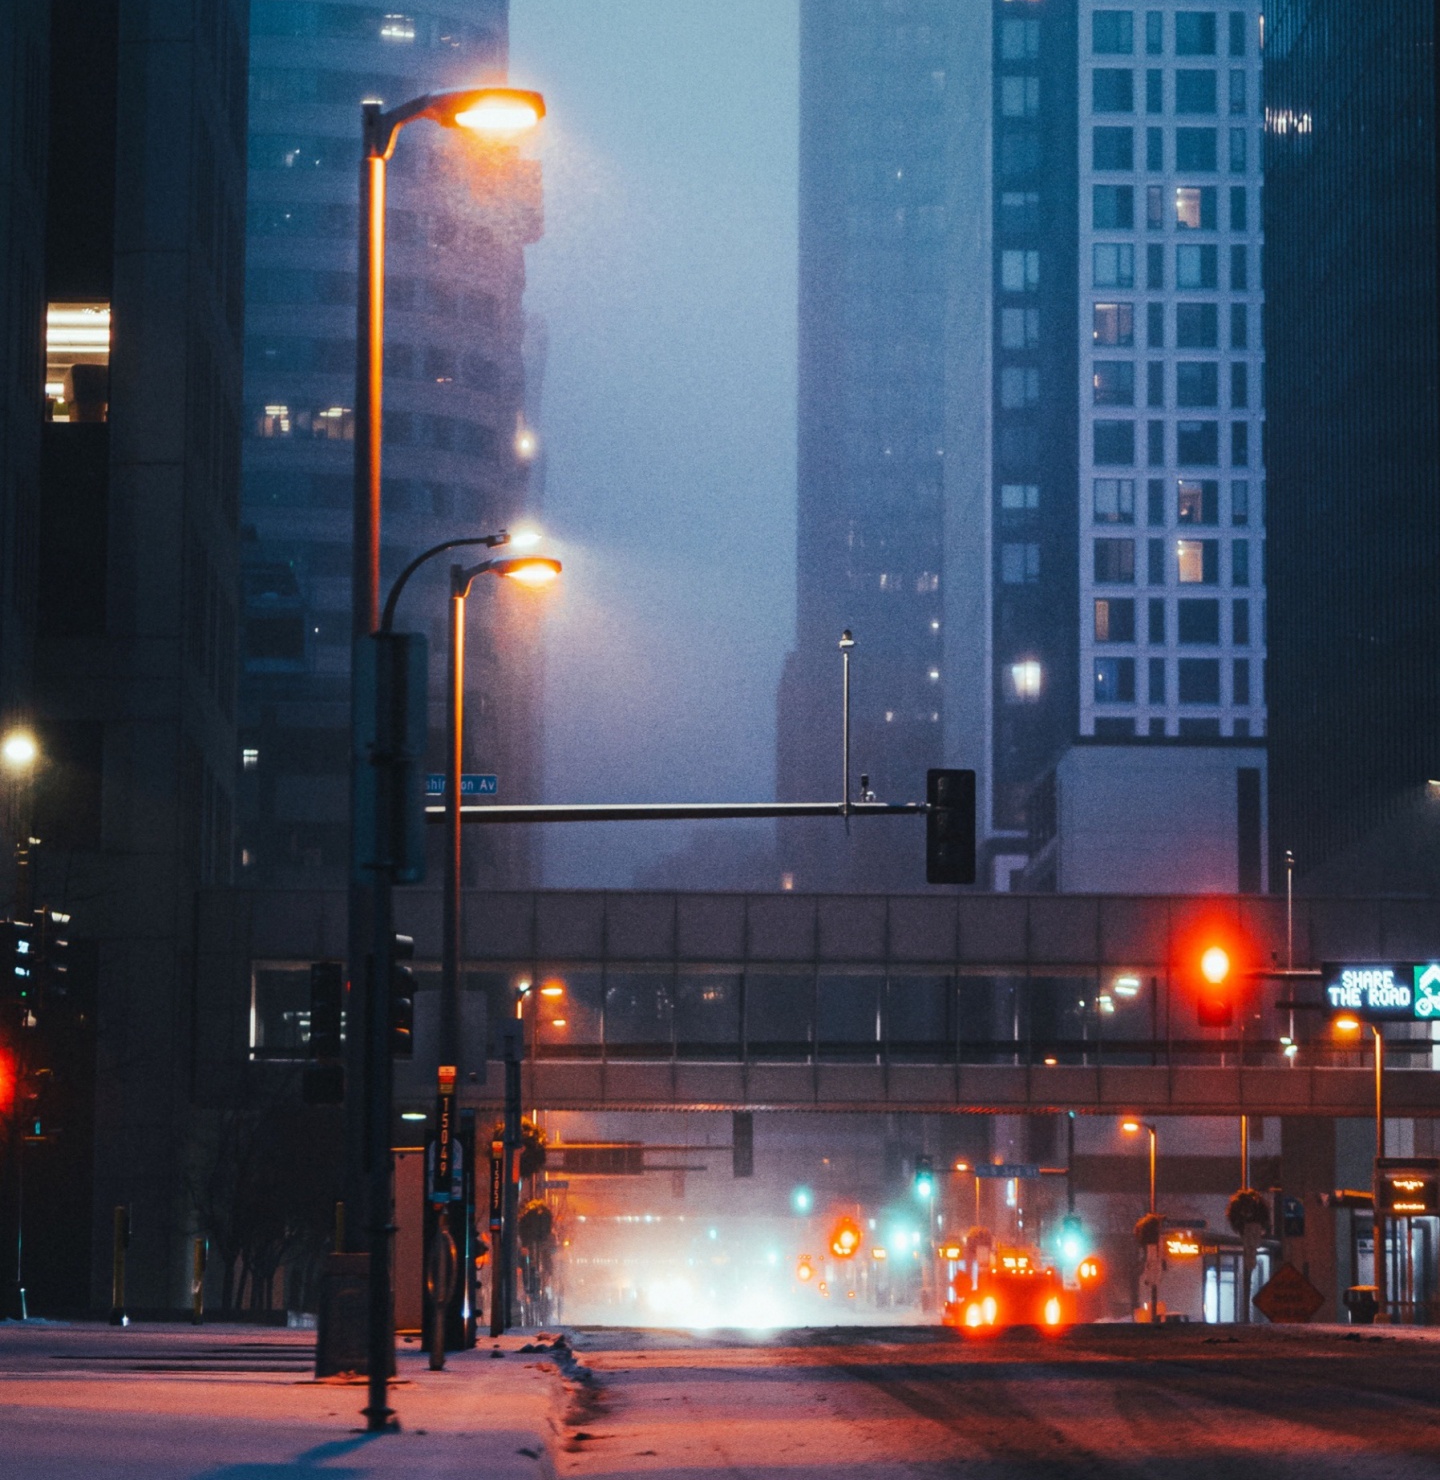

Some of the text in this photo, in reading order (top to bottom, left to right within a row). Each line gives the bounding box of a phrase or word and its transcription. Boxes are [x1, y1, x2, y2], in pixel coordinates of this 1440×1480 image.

[480, 779, 495, 791] Av
[1341, 970, 1395, 990] SHARE
[1327, 987, 1411, 1007] THE ROAD
[440, 1097, 449, 1176] 15049
